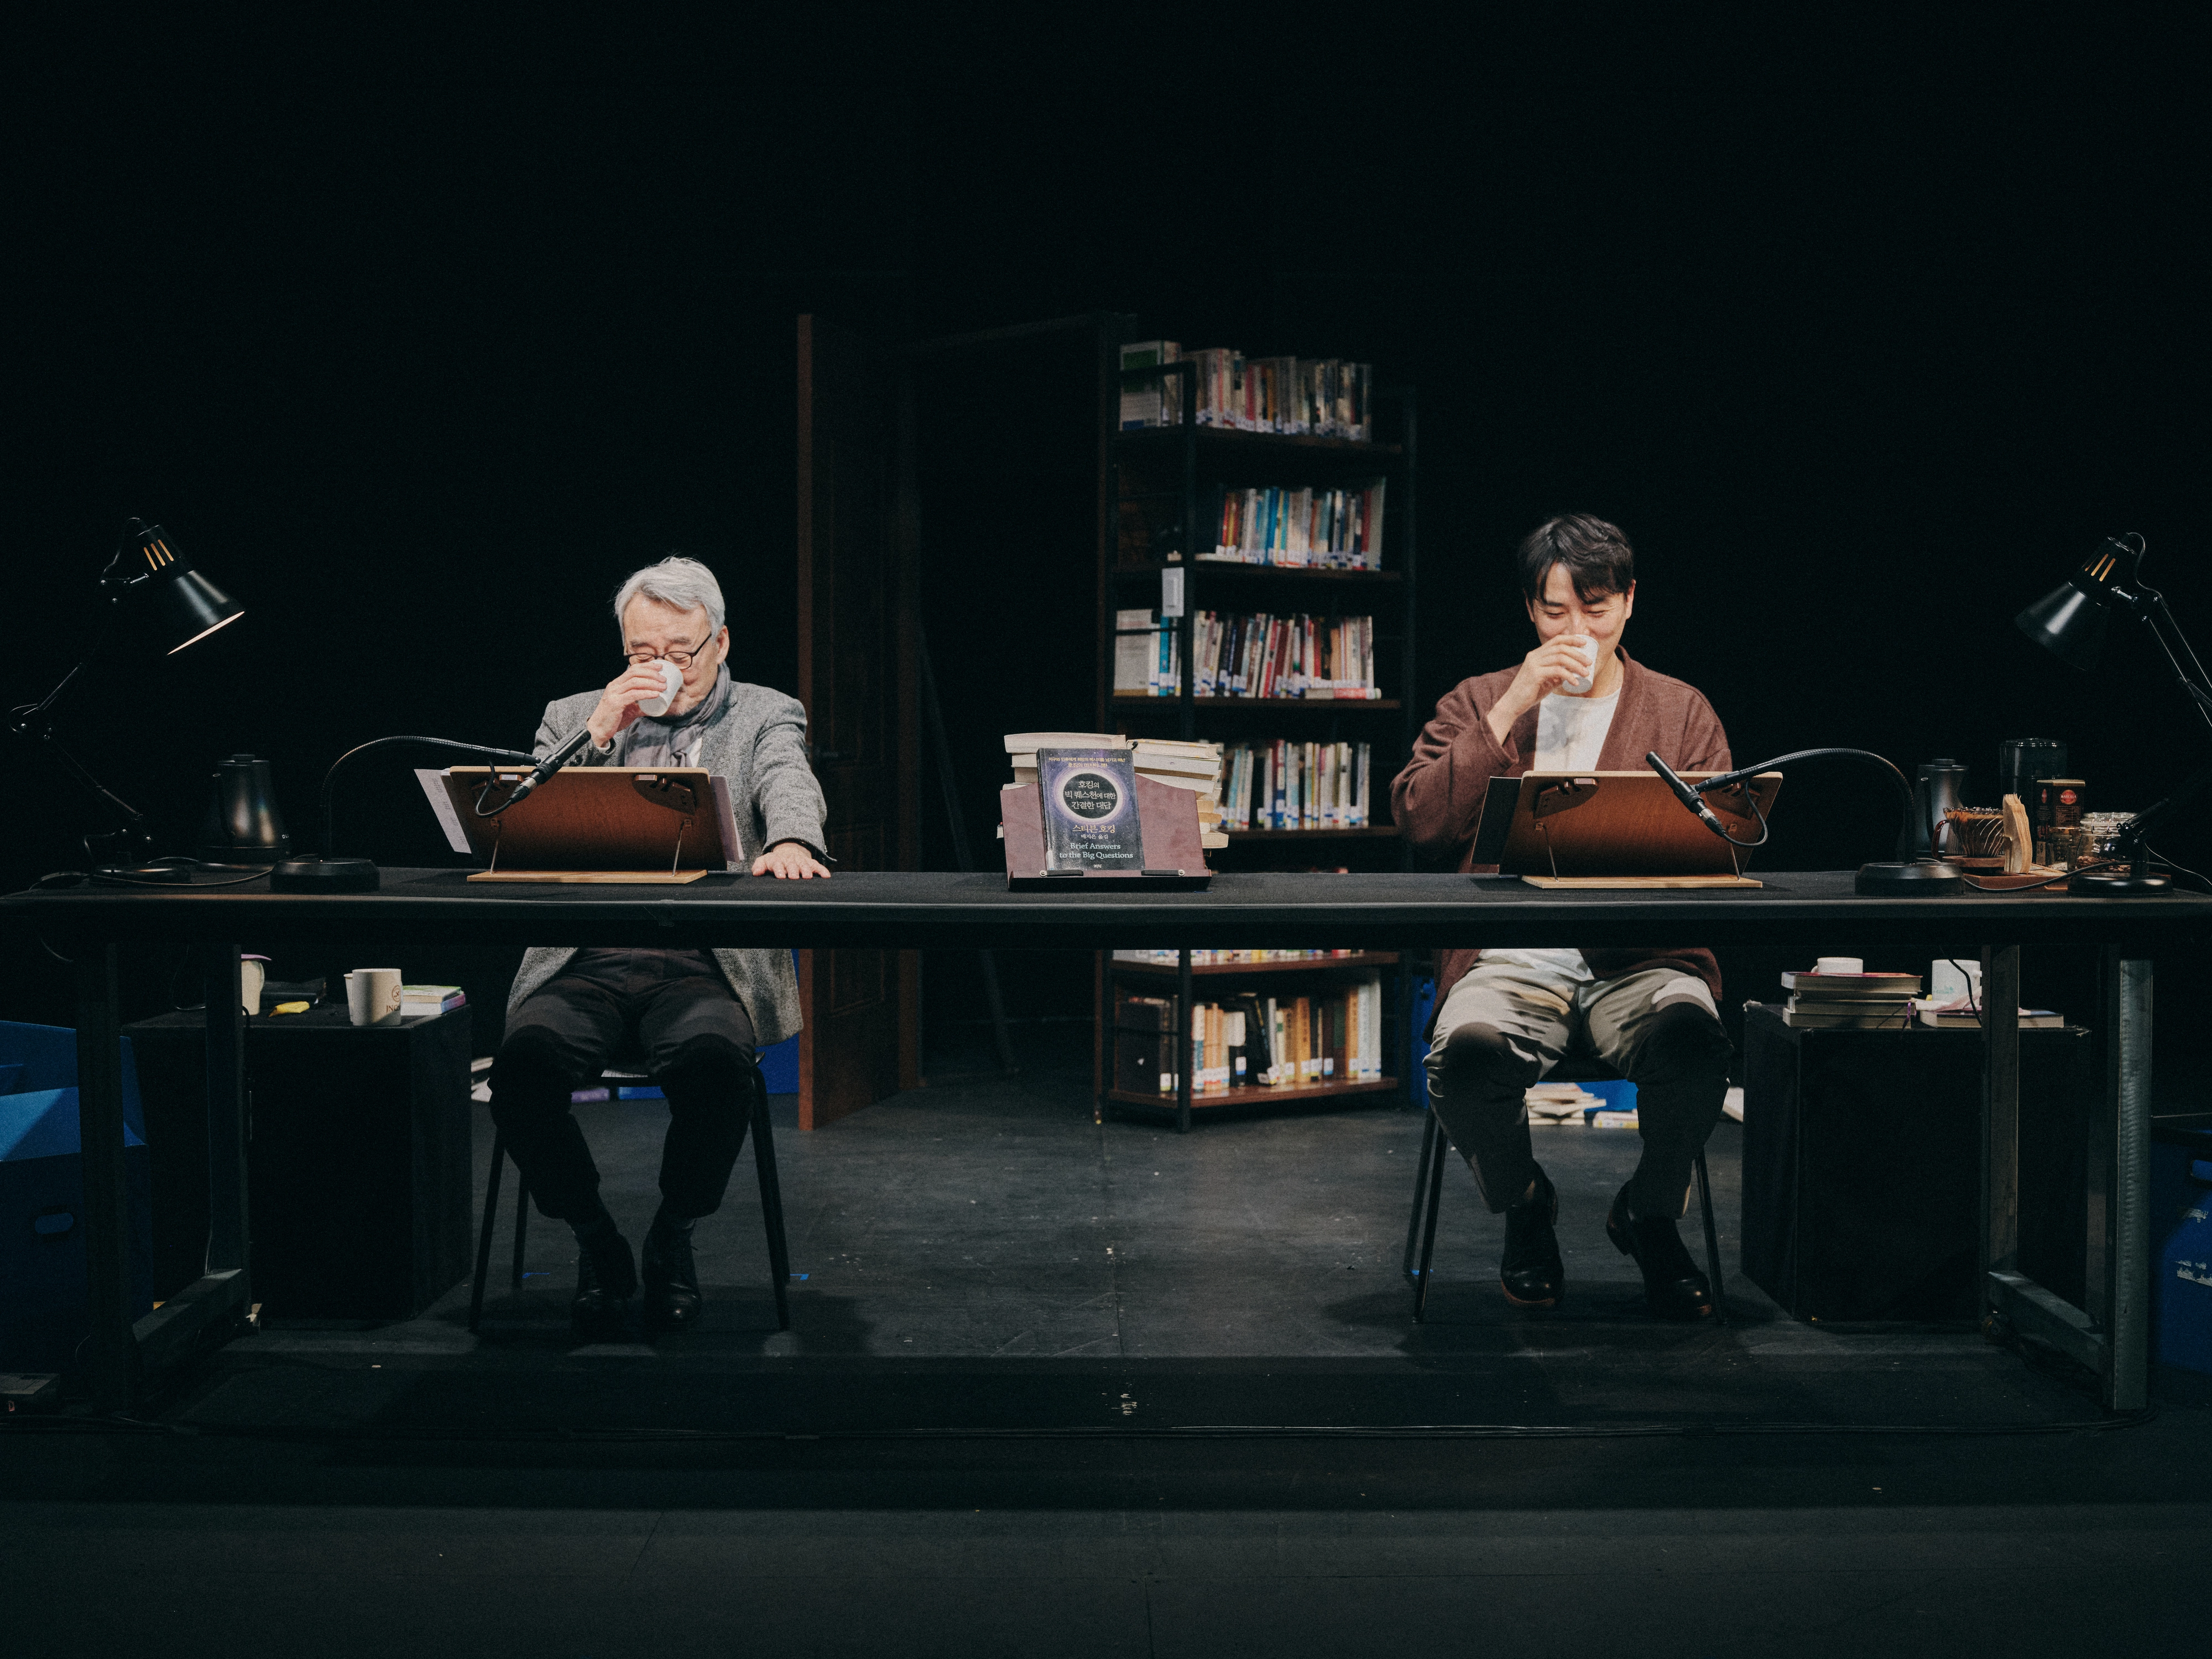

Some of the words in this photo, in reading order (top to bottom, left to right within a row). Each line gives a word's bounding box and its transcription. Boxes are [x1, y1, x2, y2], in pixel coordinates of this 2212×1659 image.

[1078, 780, 1100, 789] 호킹의
[1065, 791, 1073, 799] 빅
[1074, 791, 1103, 799] 퀘스천에
[1096, 801, 1112, 810] 대답
[1072, 824, 1098, 833] 스티븐
[1098, 825, 1115, 833] 호킹
[1082, 852, 1095, 860] Big
